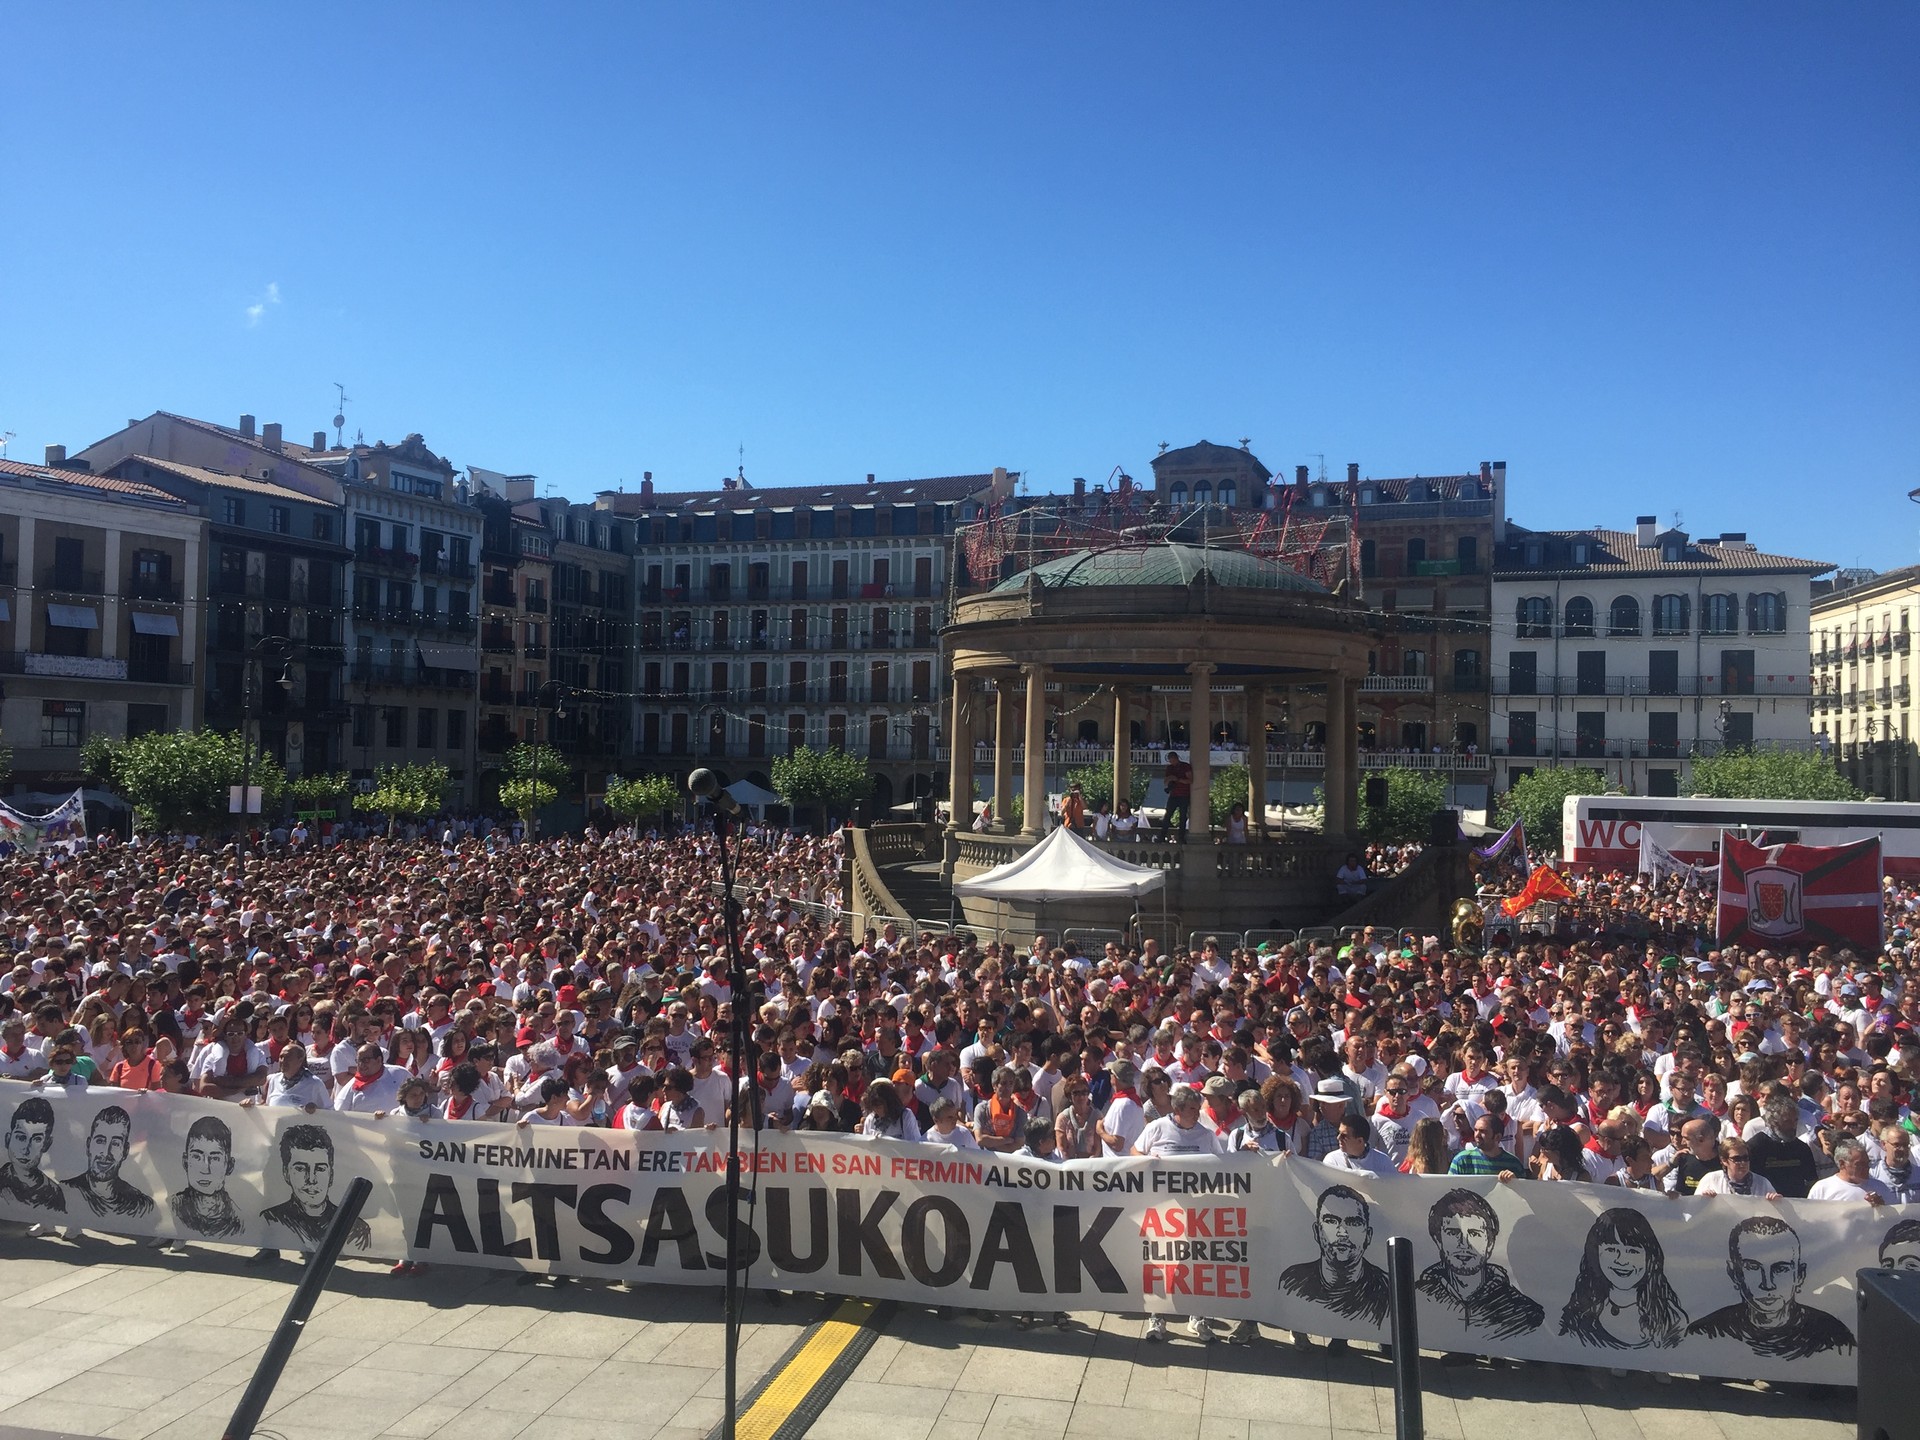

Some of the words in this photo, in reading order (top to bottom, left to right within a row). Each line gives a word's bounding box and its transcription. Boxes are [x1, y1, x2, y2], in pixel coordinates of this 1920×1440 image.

[1579, 819, 1642, 849] WC
[419, 1139, 466, 1163] SAN
[473, 1144, 630, 1171] FERMINETAN
[638, 1150, 680, 1172] ERE
[684, 1147, 787, 1173] TAMBIÉN
[795, 1152, 825, 1173] EN
[832, 1154, 881, 1175] SAN
[891, 1157, 982, 1185] FERMIN
[985, 1166, 1050, 1189] ALSO
[1059, 1170, 1084, 1191] IN
[1092, 1171, 1144, 1193] SAN
[1152, 1171, 1251, 1194] FERMIN
[414, 1173, 1128, 1294] ALTSASUKOAK
[1139, 1207, 1247, 1237] ASKE!
[1142, 1241, 1248, 1262] ¡LIBRES!
[1142, 1264, 1251, 1298] FREE!
